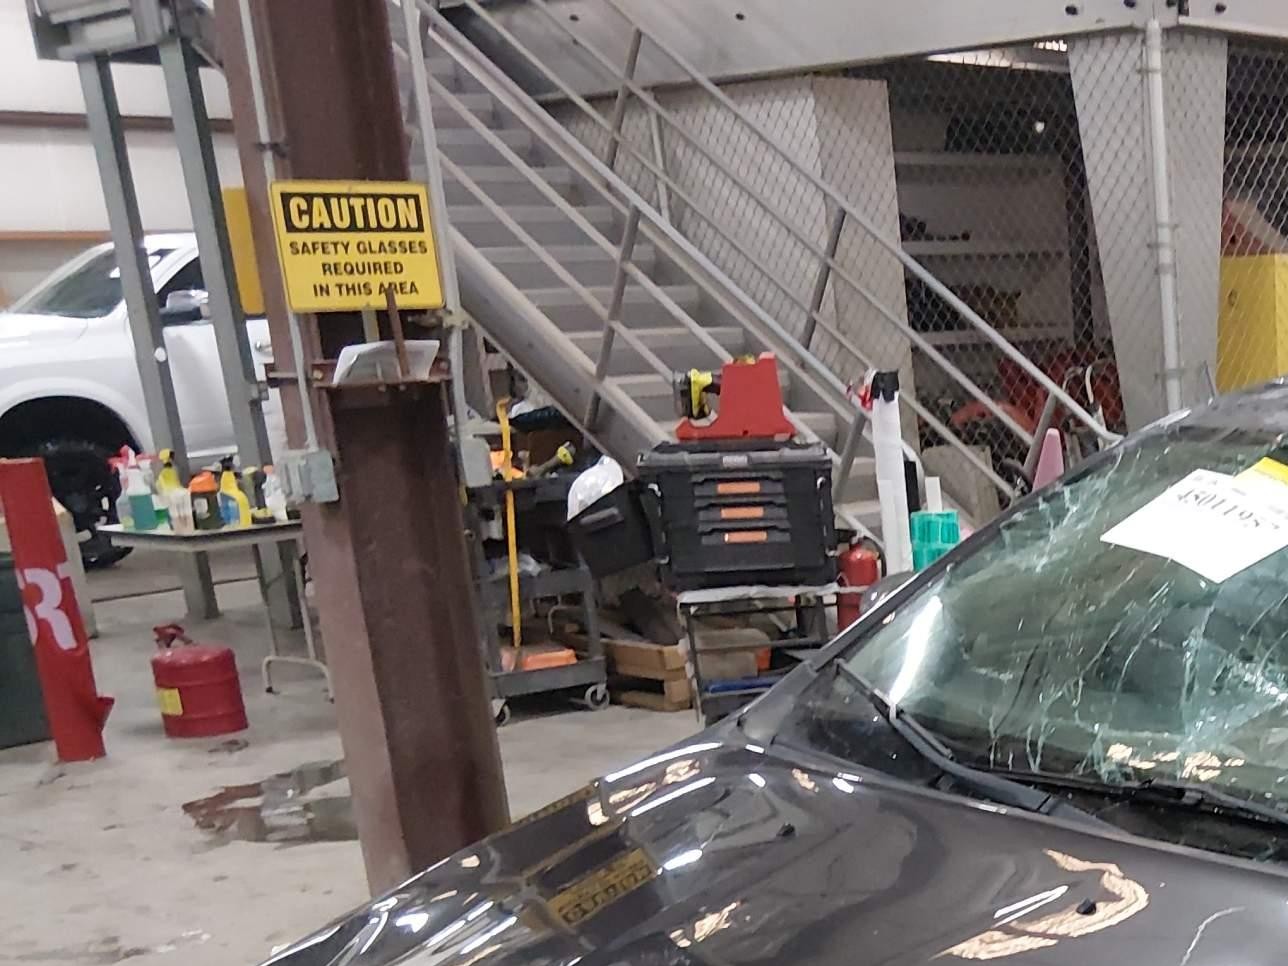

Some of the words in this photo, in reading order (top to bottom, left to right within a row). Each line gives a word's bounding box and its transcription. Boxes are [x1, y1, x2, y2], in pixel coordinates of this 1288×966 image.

[289, 196, 419, 229] CAUTION
[289, 241, 350, 256] SAFETY
[356, 240, 428, 255] GLASSES
[321, 261, 404, 276] REQUIRED
[313, 283, 330, 297] IN
[335, 282, 373, 296] THIS
[378, 281, 419, 296] AREA
